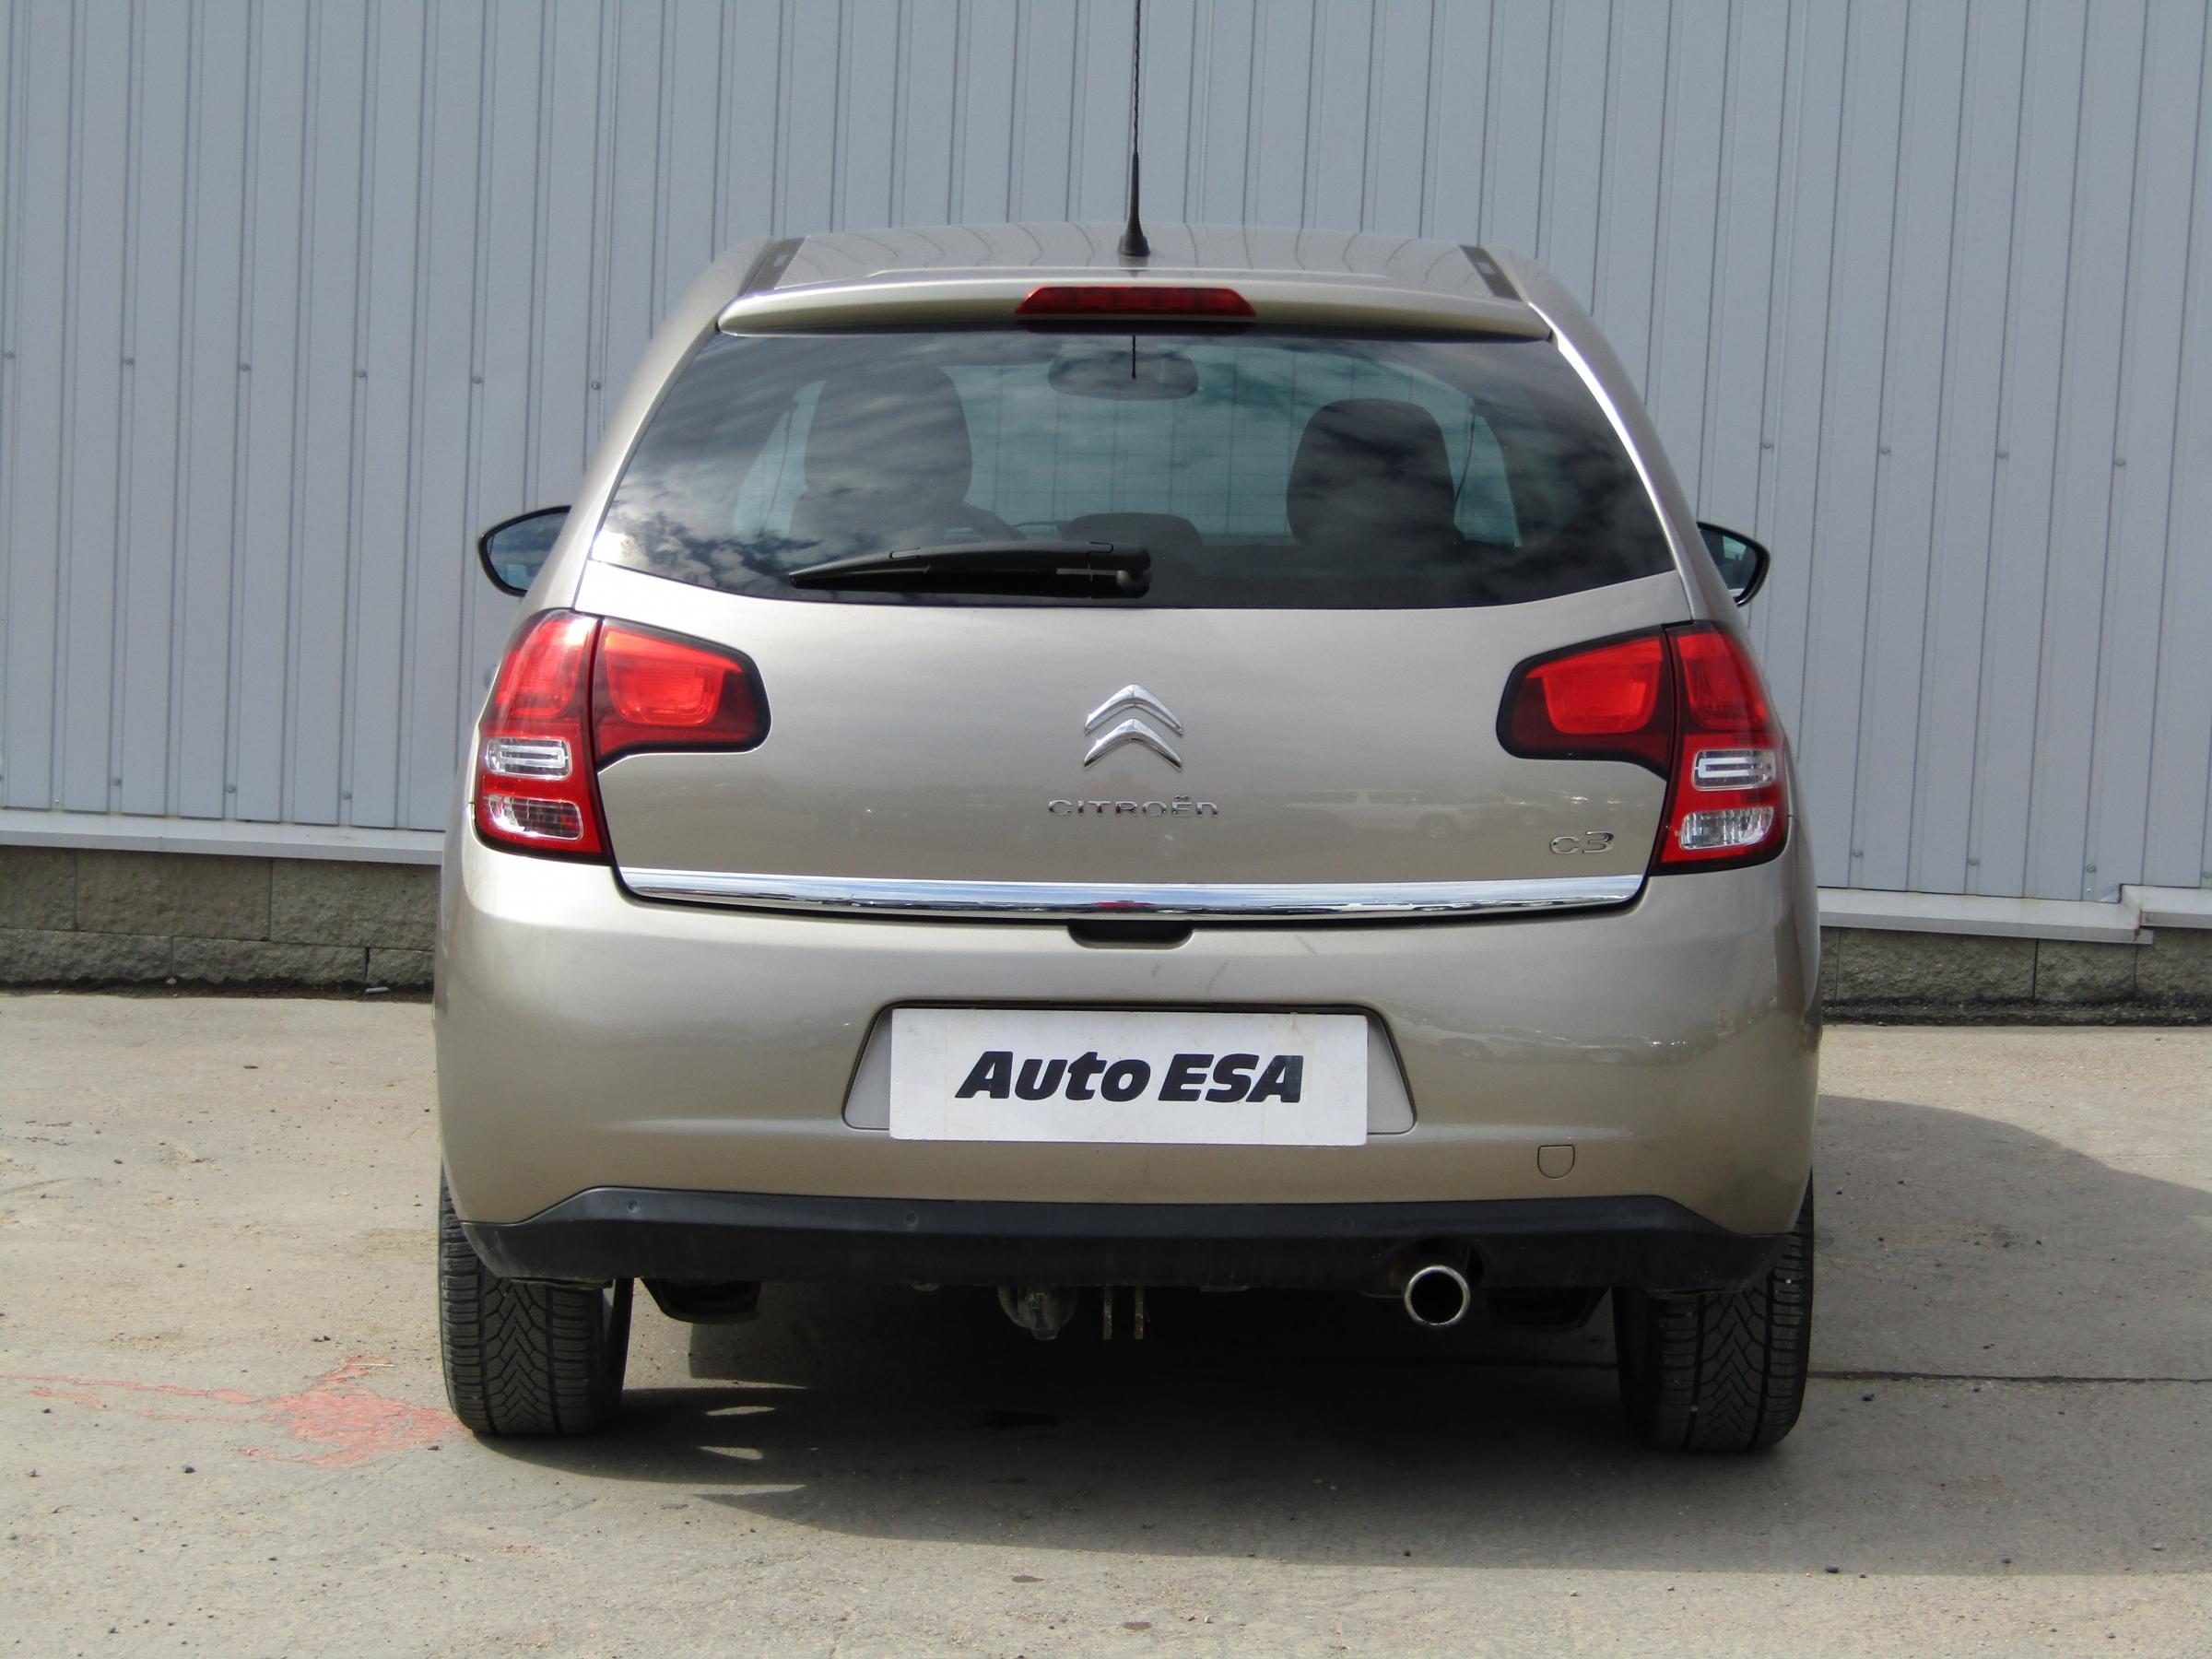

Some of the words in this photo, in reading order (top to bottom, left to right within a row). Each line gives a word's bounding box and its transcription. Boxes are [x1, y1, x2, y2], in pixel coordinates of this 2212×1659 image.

[1549, 831, 1613, 854] C3
[955, 1051, 1151, 1102] Auto
[1158, 1053, 1304, 1103] ESA
